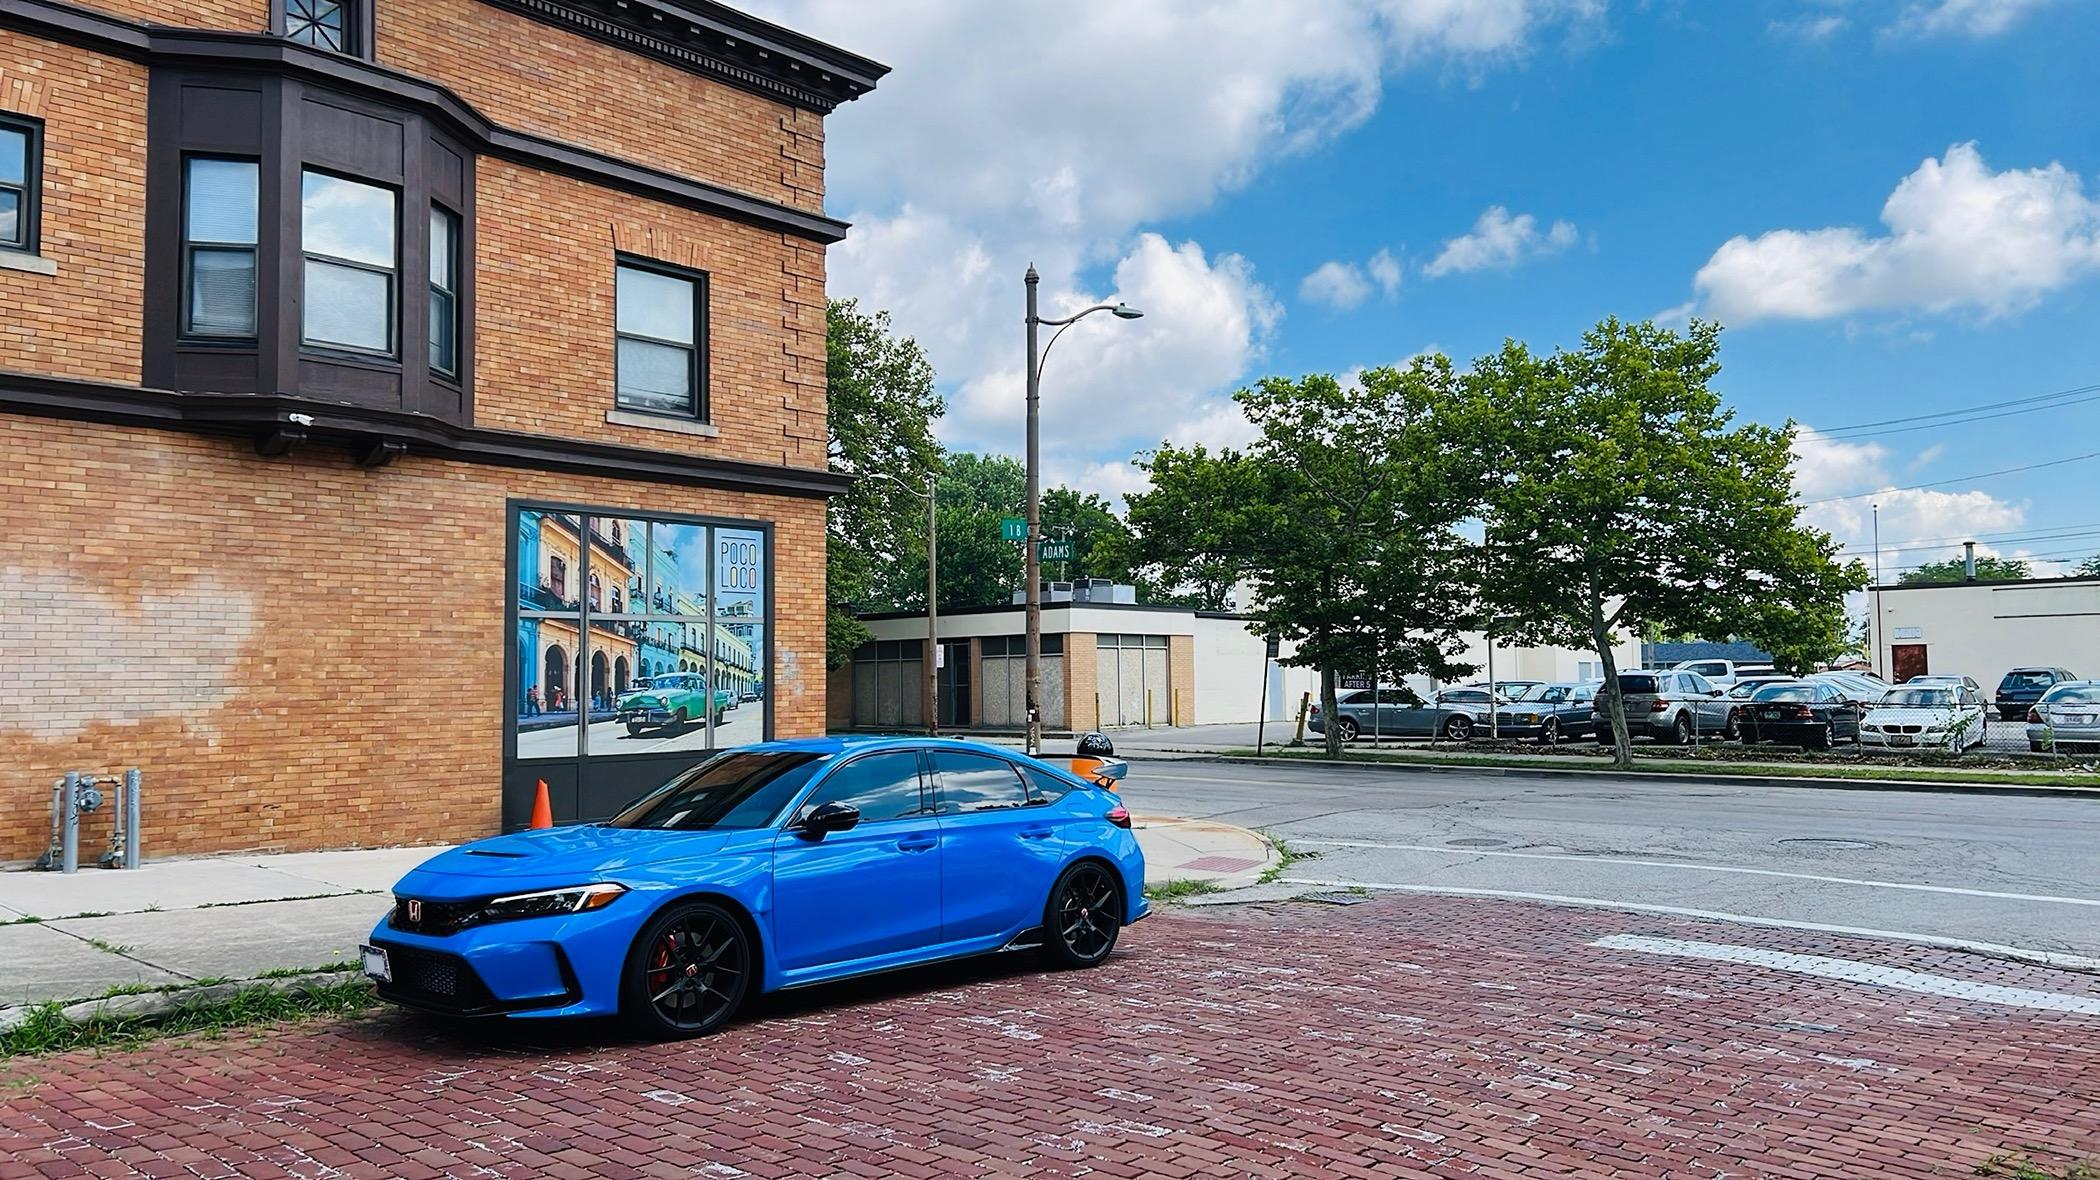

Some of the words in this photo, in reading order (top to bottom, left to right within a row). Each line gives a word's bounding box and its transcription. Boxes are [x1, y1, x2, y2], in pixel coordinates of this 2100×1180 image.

[1009, 524, 1021, 537] 18
[721, 541, 757, 566] POCO
[1042, 545, 1070, 559] ADAMS
[721, 566, 757, 589] LOCO
[1344, 680, 1365, 689] AFTER
